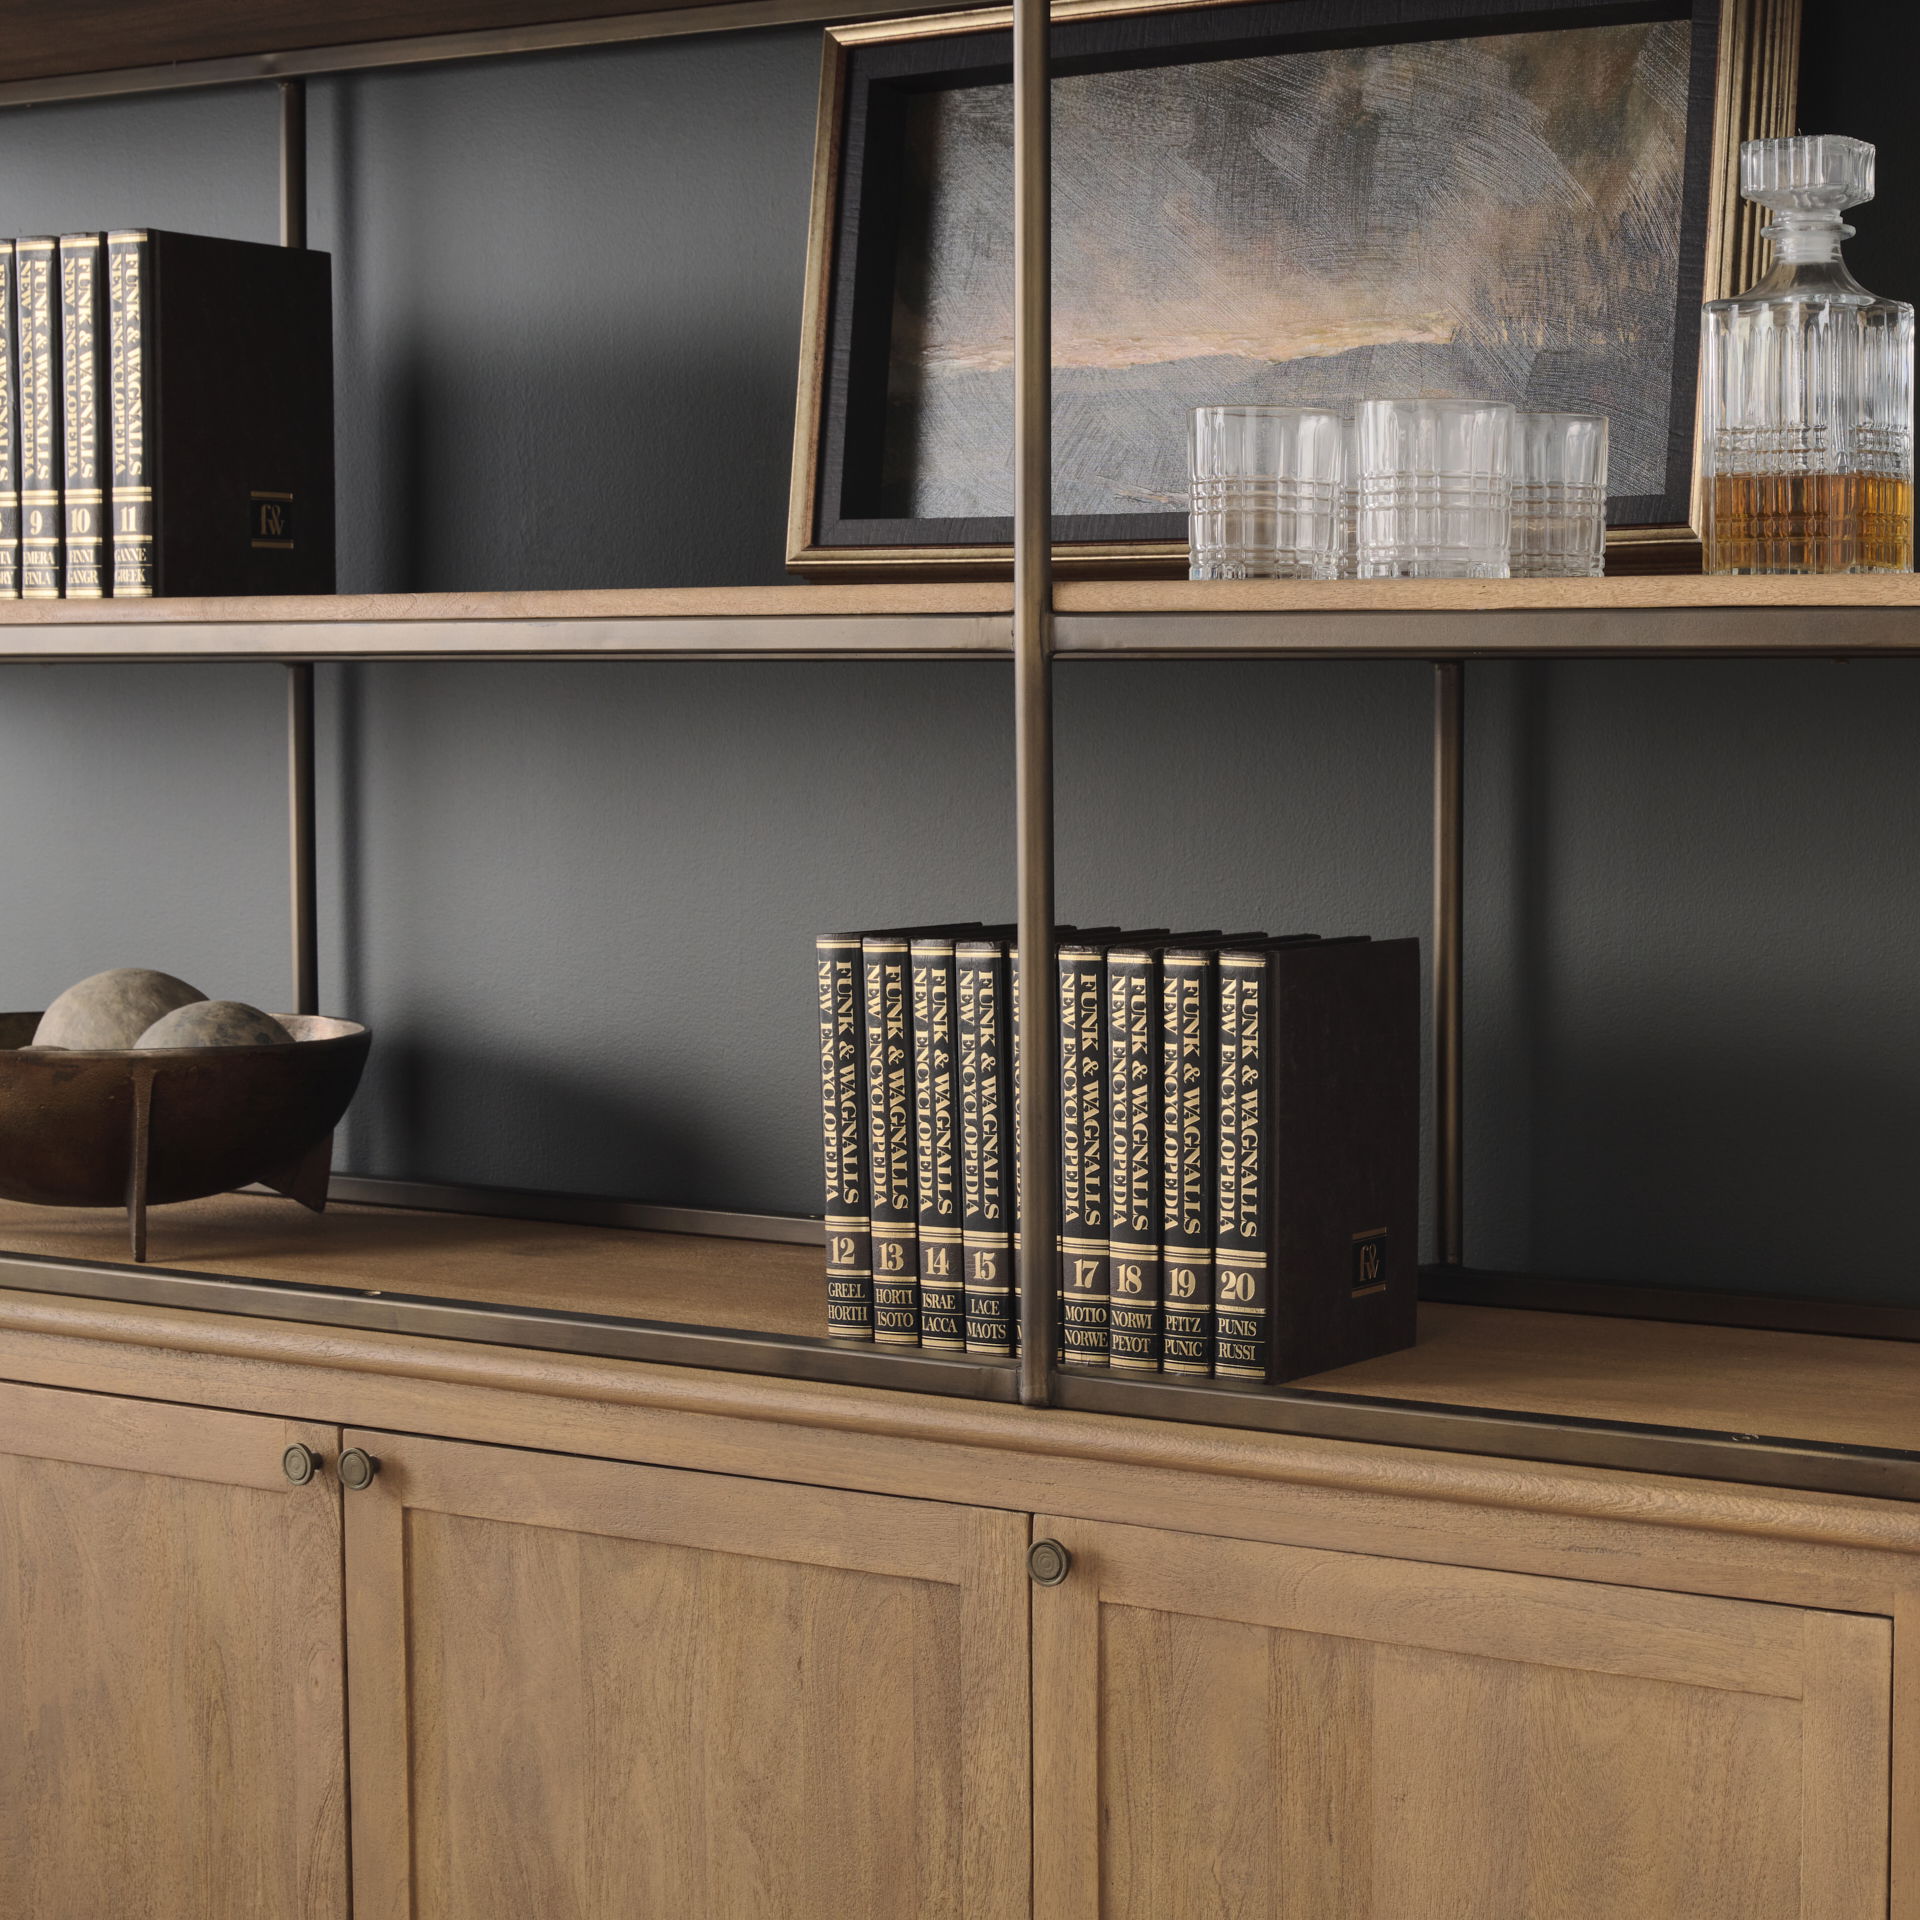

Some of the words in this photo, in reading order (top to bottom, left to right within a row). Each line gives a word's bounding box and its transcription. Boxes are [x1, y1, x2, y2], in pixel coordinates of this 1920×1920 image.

[20, 261, 31, 309] NEW
[34, 261, 48, 327] FUNK
[64, 258, 75, 308] NEW
[78, 258, 91, 325] FUNK
[111, 254, 121, 303] NEW
[125, 254, 140, 321] FUNK
[36, 333, 48, 349] &
[79, 331, 91, 347] &
[126, 328, 140, 344] &
[22, 317, 34, 479] ENCYCLOPEDIA
[36, 353, 49, 480] WAGNALLS
[66, 315, 77, 477] ENCYCLOPEDIA
[79, 351, 93, 478] WAGNALLS
[113, 311, 125, 475] ENCYCLOPEDIA
[126, 348, 142, 475] WAGNALLS
[30, 511, 42, 535] 9
[71, 508, 90, 533] 10
[121, 506, 136, 531] 11
[25, 571, 51, 584] FINLA
[68, 570, 98, 583] GANGR
[114, 548, 146, 561] GANNE
[115, 568, 146, 582] GREEK
[818, 960, 832, 1014] NEW
[836, 960, 854, 1034] FUNK
[868, 964, 882, 1019] NEW
[886, 965, 903, 1039] FUNK
[914, 967, 928, 1023] NEW
[931, 969, 948, 1044] FUNK
[960, 970, 974, 1026] NEW
[978, 971, 995, 1047] FUNK
[1062, 972, 1076, 1030] NEW
[1112, 975, 1126, 1032] NEW
[1163, 977, 1178, 1035] NEW
[1222, 978, 1236, 1037] NEW
[1081, 974, 1098, 1051] FUNK
[1130, 977, 1147, 1054] FUNK
[1182, 978, 1200, 1056] FUNK
[1241, 980, 1258, 1059] FUNK
[840, 1041, 854, 1060] &
[888, 1046, 904, 1065] &
[934, 1050, 949, 1068] &
[980, 1053, 996, 1072] &
[1082, 1057, 1098, 1076] &
[1132, 1060, 1148, 1080] &
[1183, 1062, 1200, 1084] &
[1241, 1065, 1258, 1085] &
[821, 1022, 840, 1201] ENCYCLOPEDIA
[839, 1064, 858, 1204] WAGNALLS
[868, 1027, 888, 1208] ENCYCLOPEDIA
[915, 1031, 933, 1212] ENCYCLOPEDIA
[961, 1034, 980, 1217] ENCYCLOPEDIA
[1063, 1038, 1079, 1223] ENCYCLOPEDIA
[1112, 1040, 1127, 1228] ENCYCLOPEDIA
[888, 1068, 908, 1210] WAGNALLS
[934, 1072, 952, 1214] WAGNALLS
[980, 1076, 999, 1220] WAGNALLS
[1082, 1080, 1100, 1226] WAGNALLS
[1132, 1084, 1148, 1231] WAGNALLS
[1164, 1042, 1178, 1230] ENCYCLOPEDIA
[1183, 1086, 1200, 1234] WAGNALLS
[1220, 1044, 1236, 1234] ENCYCLOPEDIA
[1240, 1089, 1258, 1238] WAGNALLS
[830, 1237, 855, 1264] 12
[879, 1243, 904, 1271] 13
[925, 1247, 949, 1276] 14
[972, 1251, 996, 1280] 15
[1073, 1259, 1099, 1288] 17
[828, 1283, 865, 1298] GREEL
[876, 1289, 912, 1304] HORTI
[922, 1293, 956, 1309] ISRAE
[1117, 1264, 1142, 1294] 18
[1169, 1268, 1196, 1298] 19
[1220, 1271, 1255, 1301] 20
[828, 1305, 867, 1320] HORTH
[877, 1311, 914, 1327] ISOTO
[922, 1316, 957, 1332] LACCA
[967, 1321, 1006, 1339] MAOTS
[971, 1299, 1000, 1315] LACE
[1065, 1305, 1107, 1322] MOTIO
[1111, 1311, 1152, 1330] NORWI
[1165, 1315, 1201, 1333] PFITZ
[1218, 1317, 1257, 1337] PUNIS
[1065, 1329, 1108, 1347] NORWE
[1112, 1335, 1150, 1353] PEYOT
[1165, 1339, 1203, 1357] PUNIC
[1218, 1343, 1256, 1361] RUSSI
